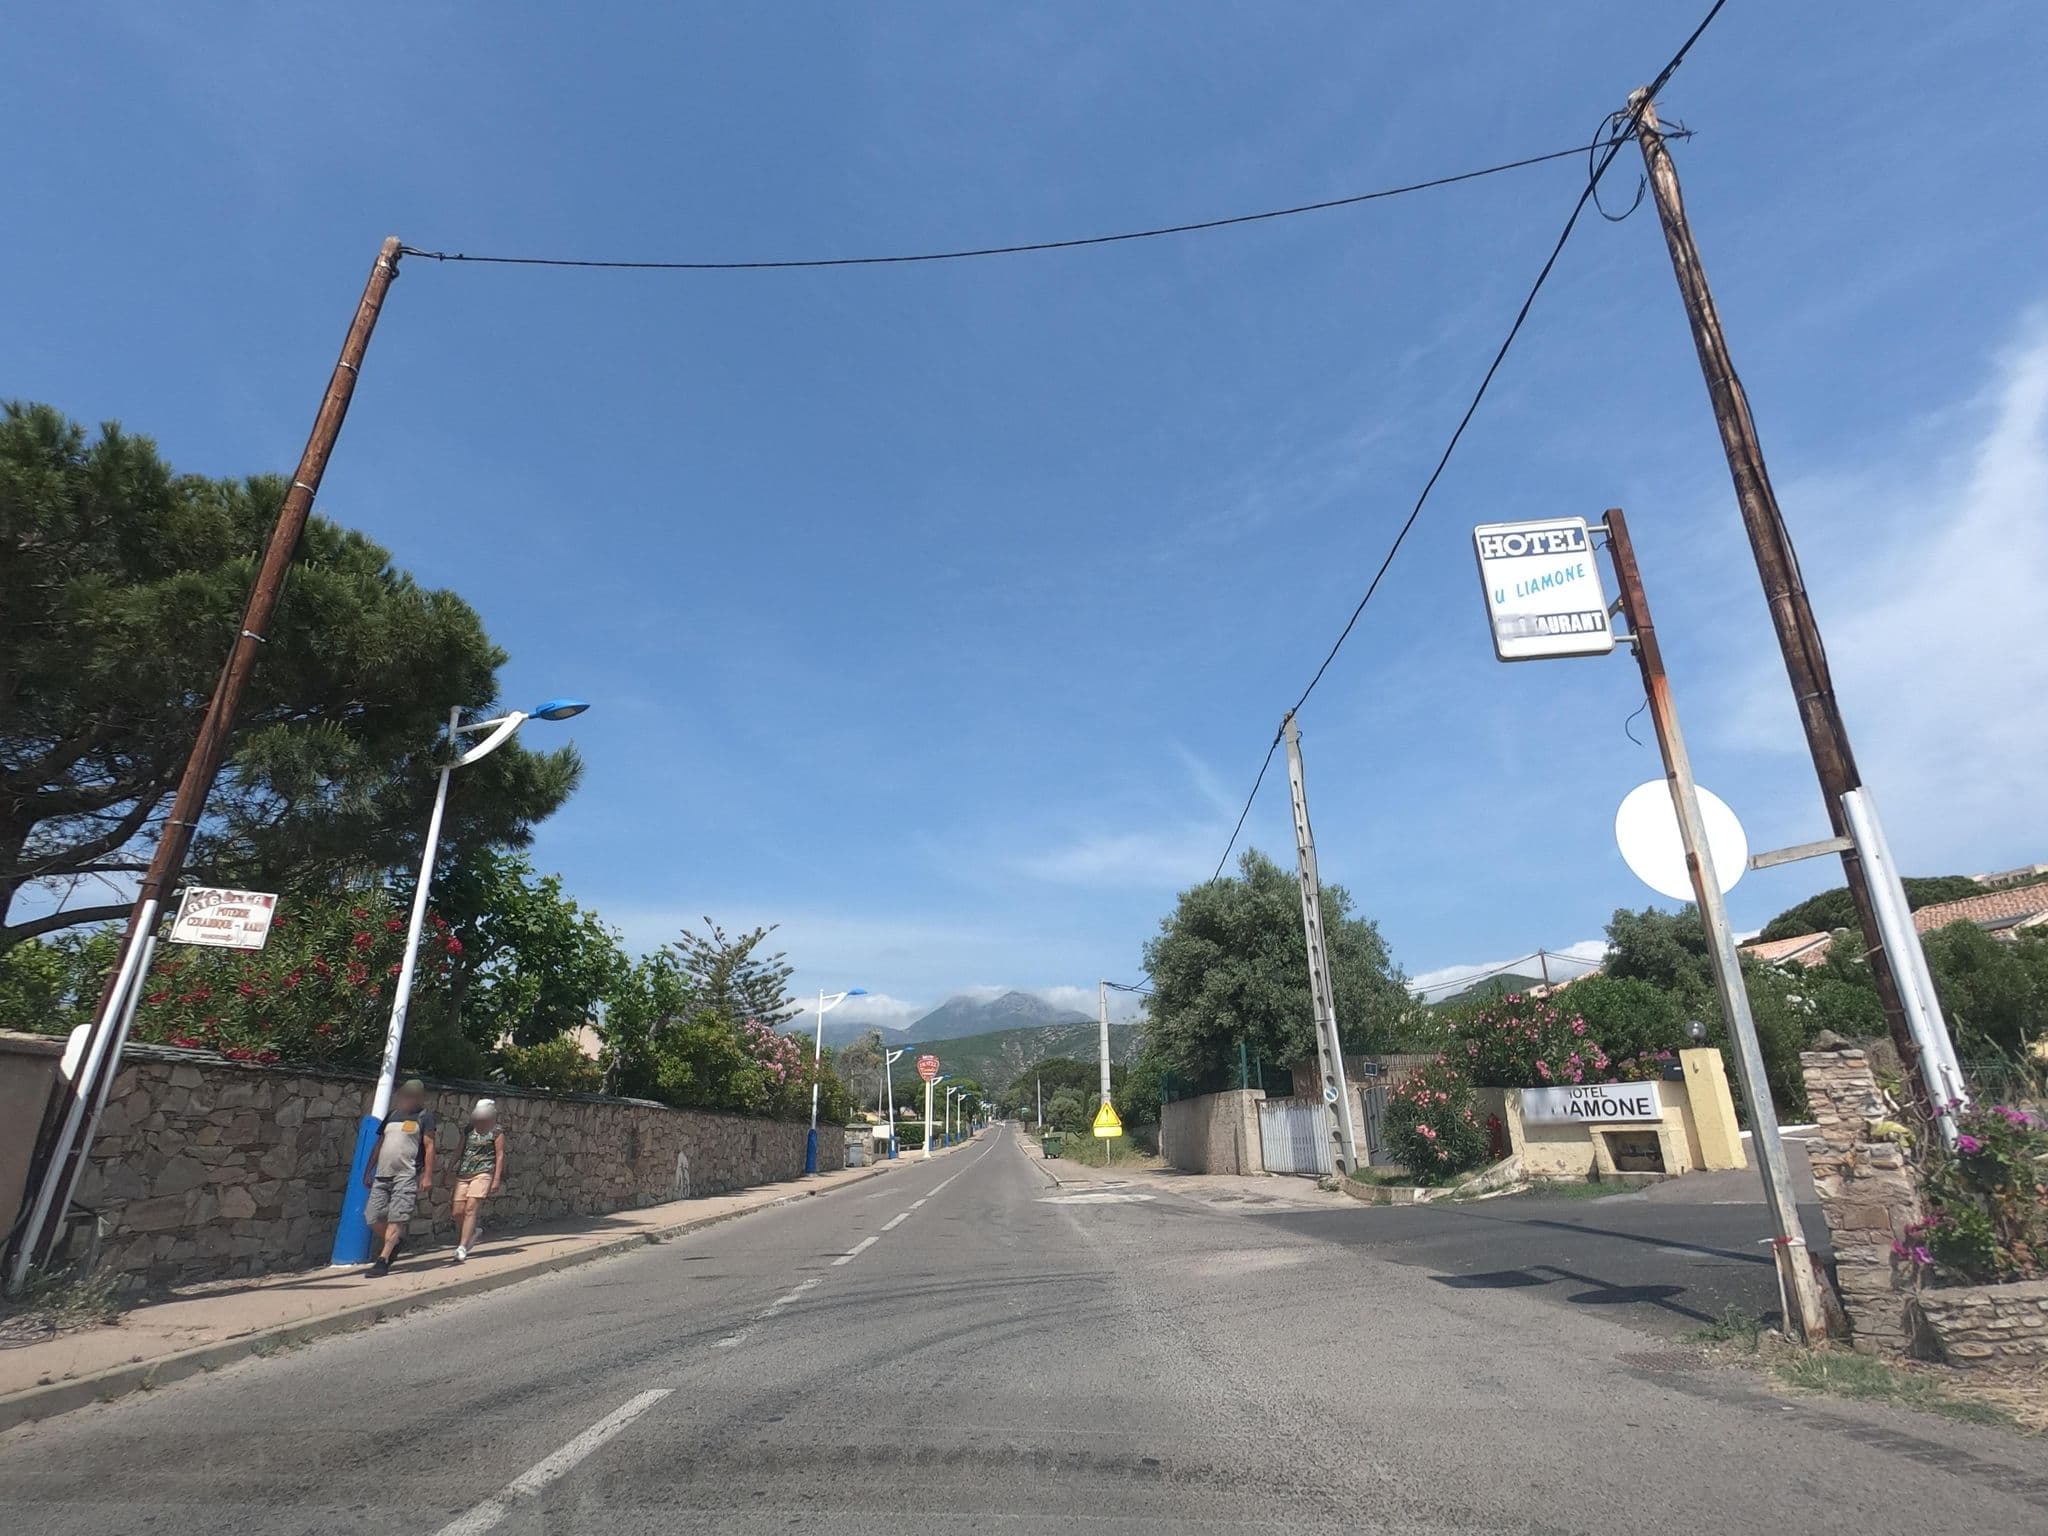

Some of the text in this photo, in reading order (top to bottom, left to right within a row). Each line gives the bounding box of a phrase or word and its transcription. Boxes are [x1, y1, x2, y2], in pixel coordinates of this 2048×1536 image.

[1480, 529, 1587, 558] HOTEL
[1494, 563, 1586, 604] U LIAMONE
